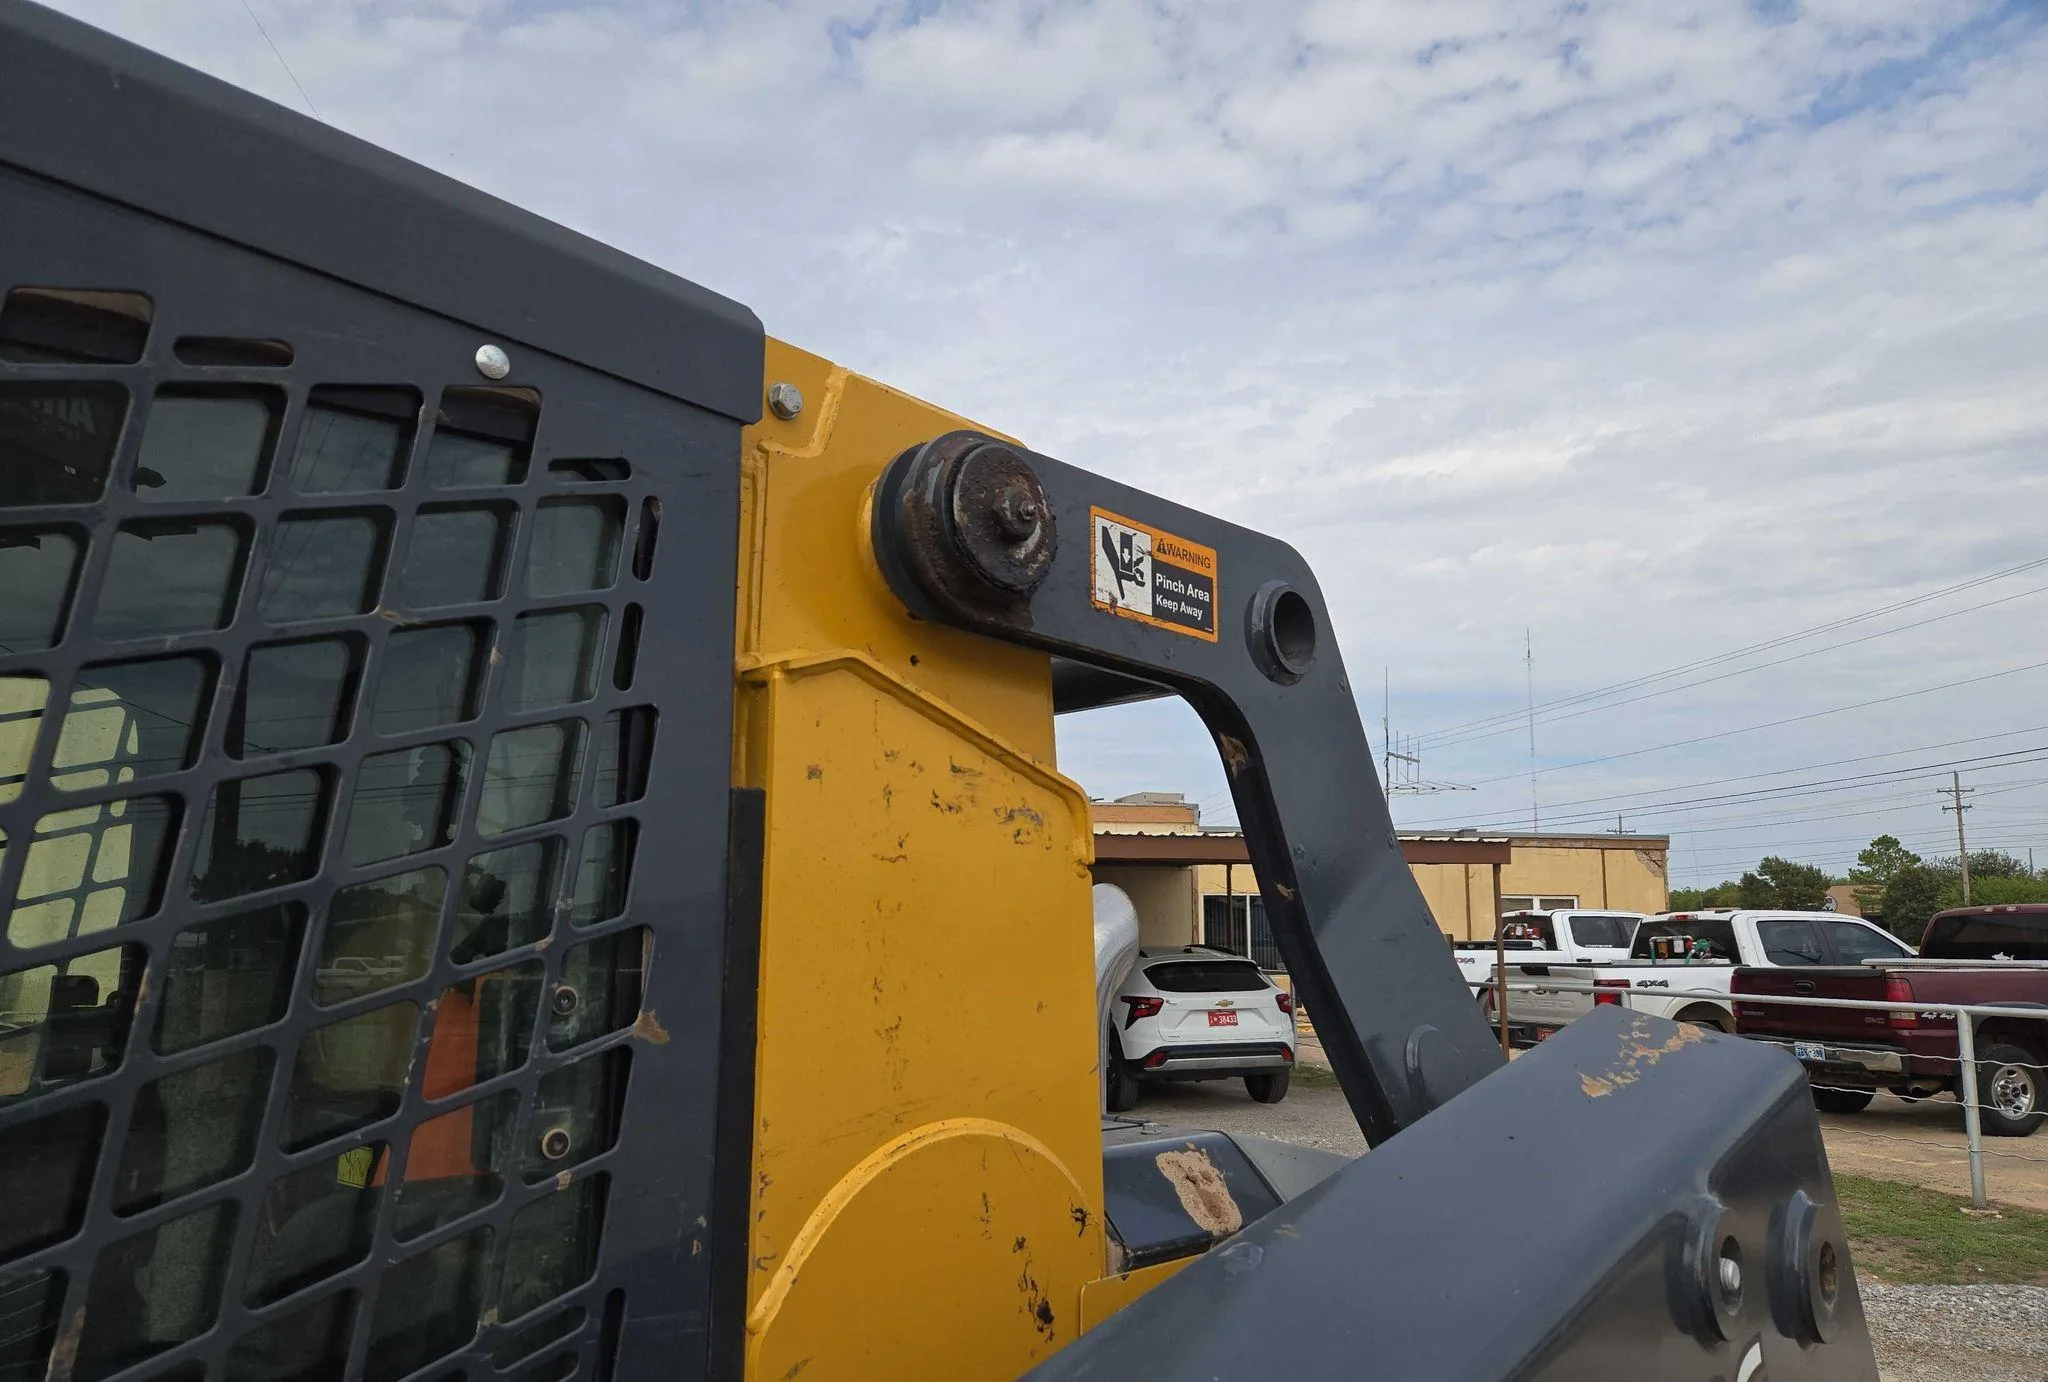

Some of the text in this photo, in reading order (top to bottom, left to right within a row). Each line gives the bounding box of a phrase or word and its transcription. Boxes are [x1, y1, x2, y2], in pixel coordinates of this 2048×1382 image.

[1166, 543, 1211, 569] WARNING
[1156, 573, 1210, 602] Pinch Area
[1156, 594, 1203, 621] Keep Away
